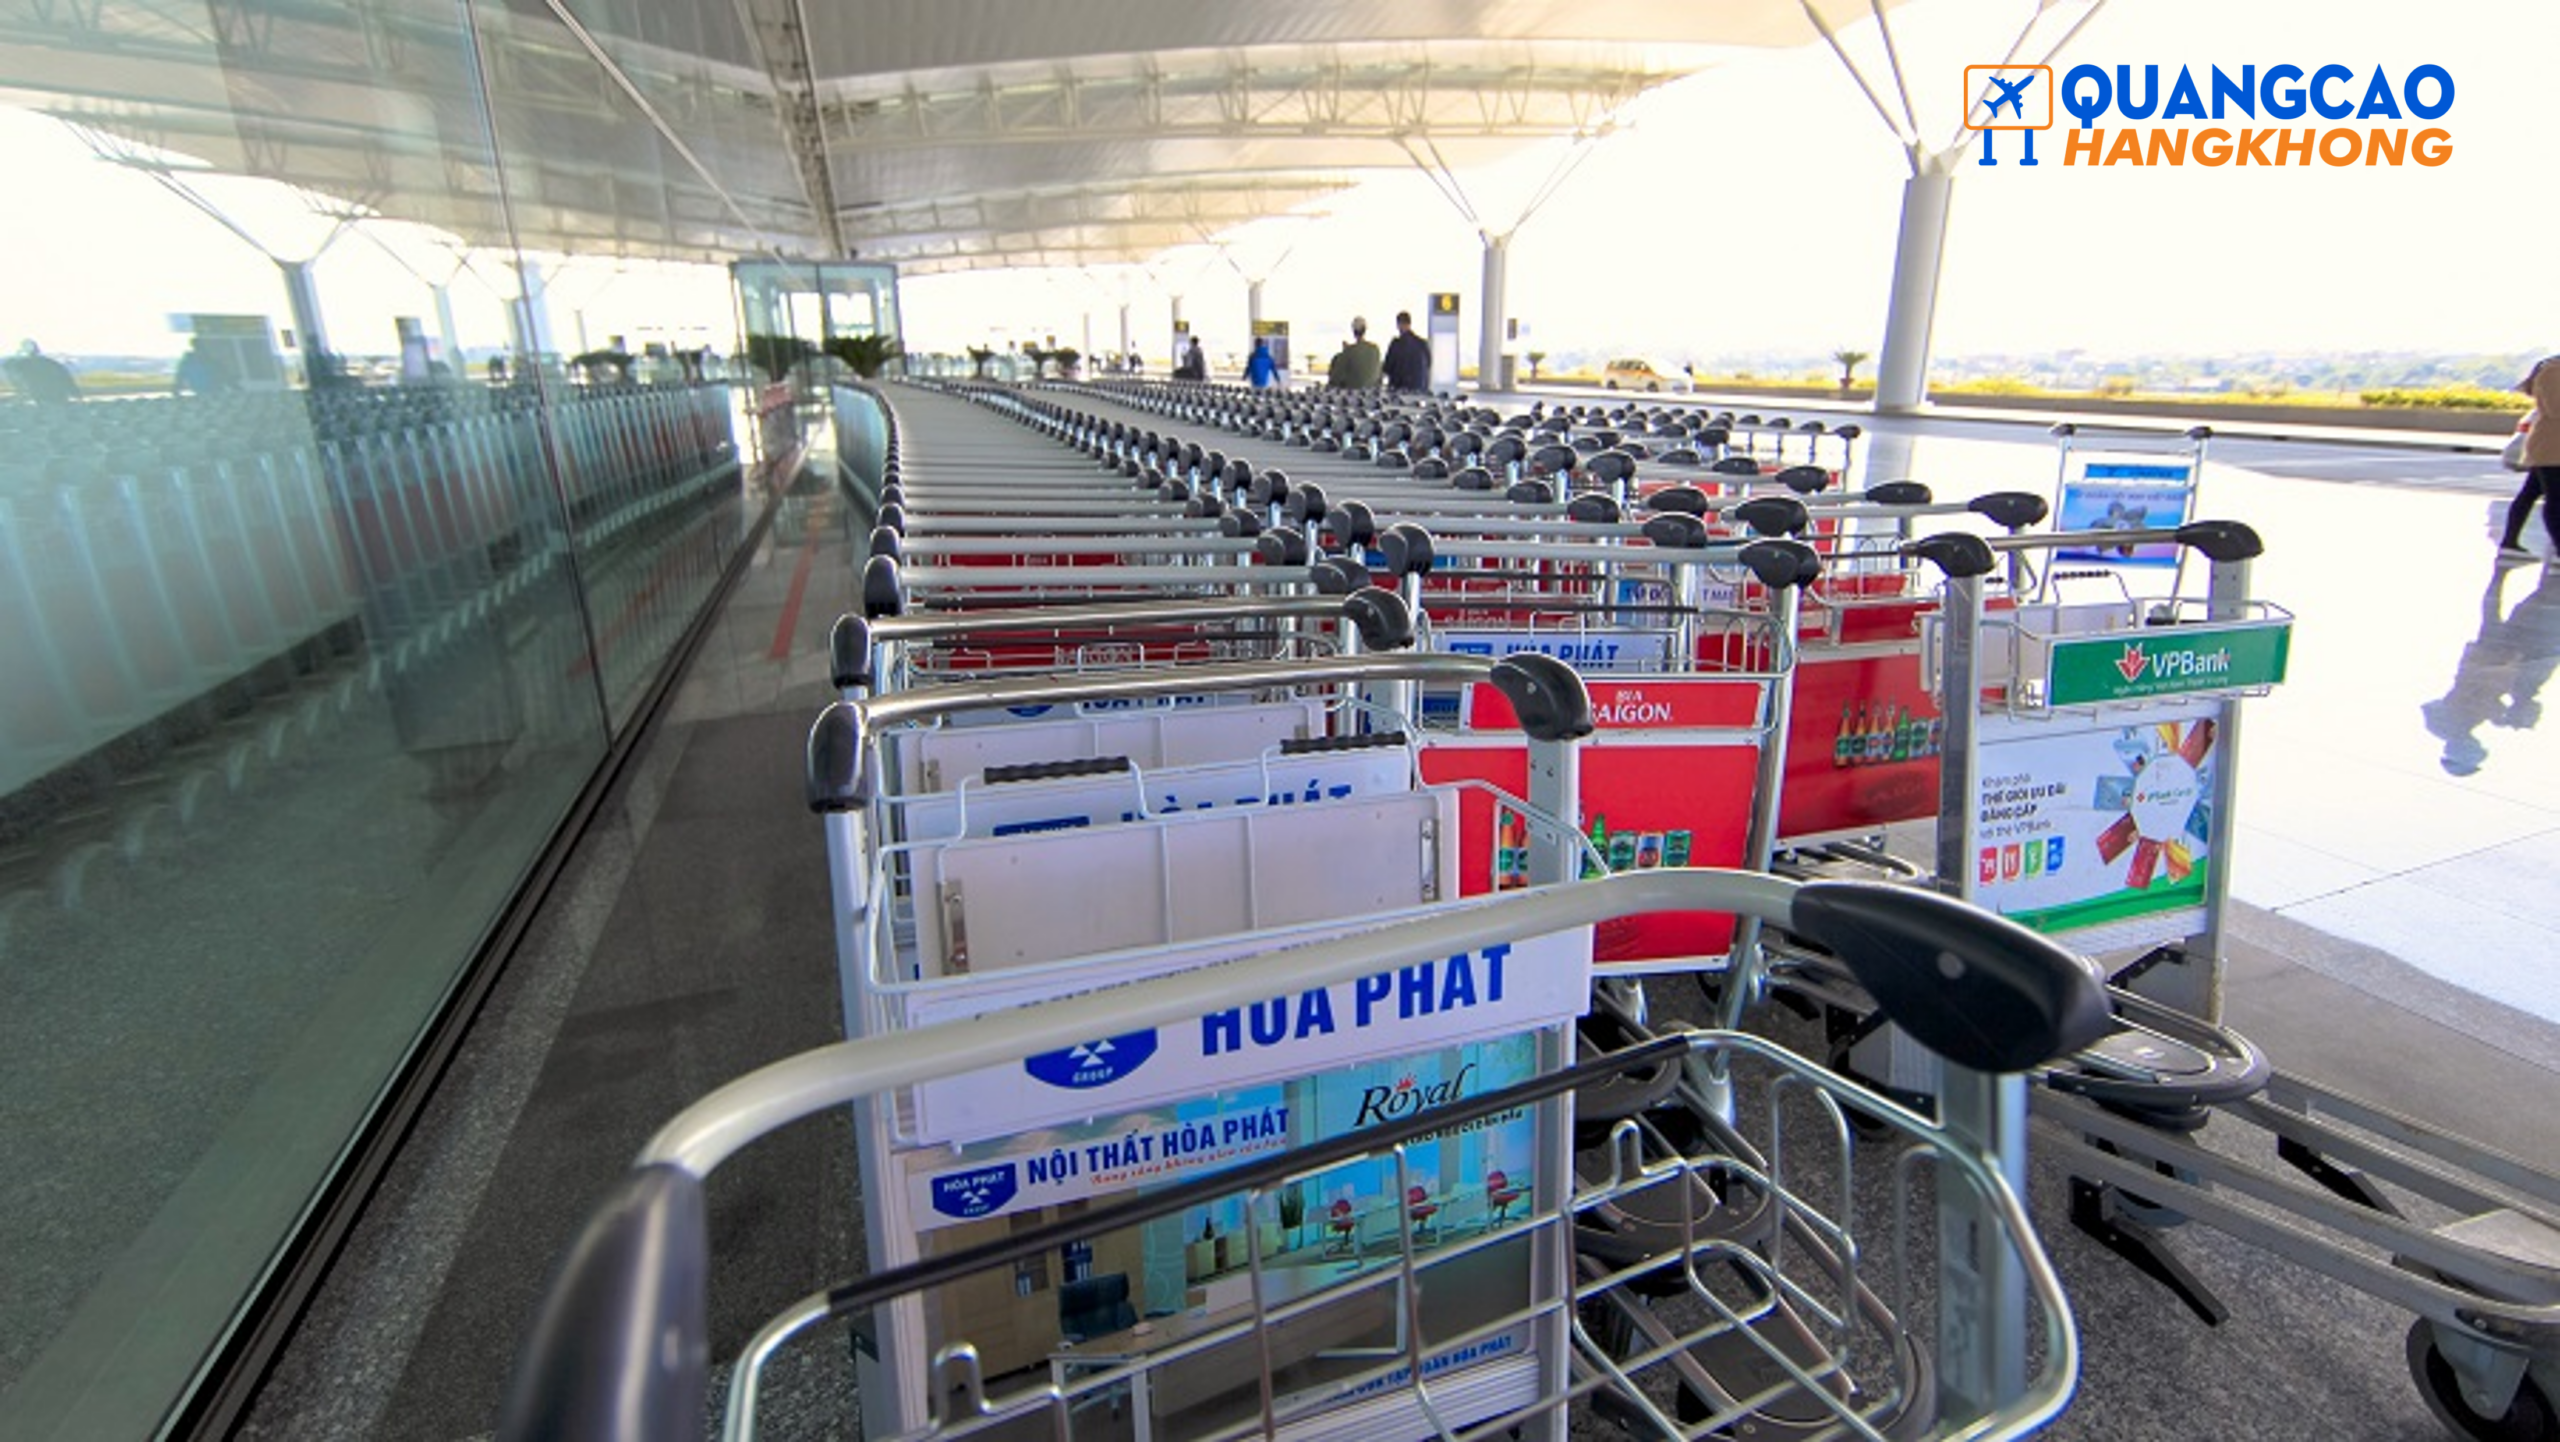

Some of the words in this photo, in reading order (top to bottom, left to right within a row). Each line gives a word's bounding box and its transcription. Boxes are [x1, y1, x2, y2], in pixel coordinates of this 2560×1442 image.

[1440, 295, 1453, 311] 6
[2152, 647, 2231, 678] VPBank
[1354, 1062, 1476, 1127] Royal
[1028, 1148, 1079, 1186] NỘI
[1086, 1128, 1154, 1172] THẤT
[1162, 1122, 1216, 1159] HÒA
[1223, 1106, 1290, 1145] PHÁT
